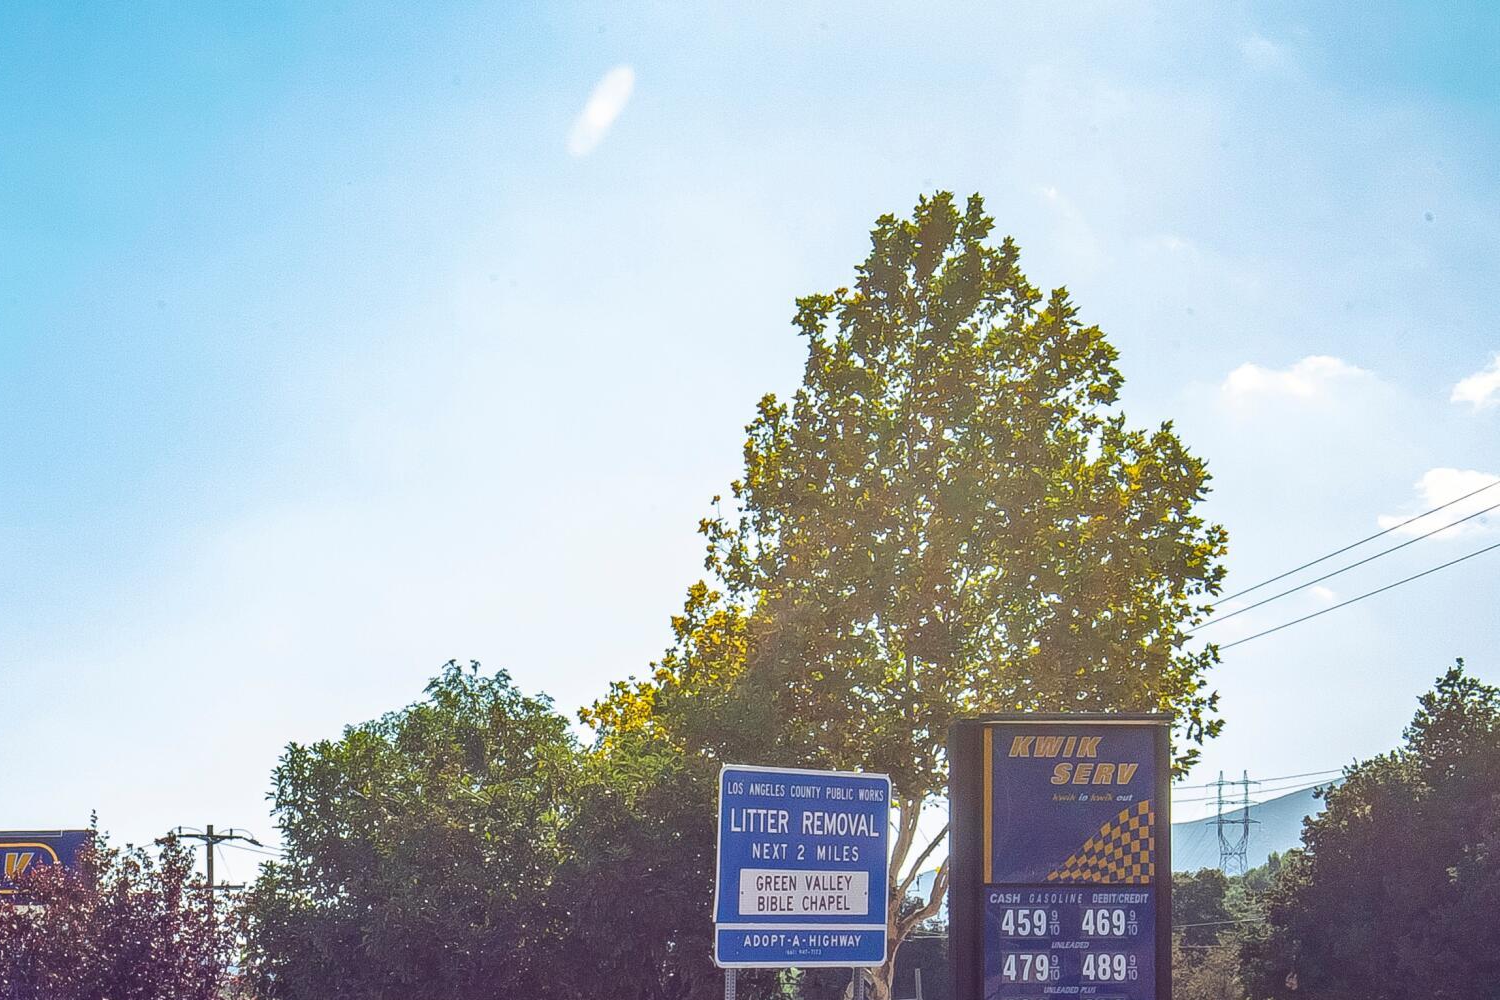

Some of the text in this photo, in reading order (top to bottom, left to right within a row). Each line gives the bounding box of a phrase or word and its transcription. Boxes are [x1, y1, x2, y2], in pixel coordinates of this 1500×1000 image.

[1008, 736, 1102, 757] KWIK
[1051, 763, 1139, 784] SERV
[727, 782, 884, 801] LOS ANGELES COUNTY PUBLIC WORKS
[731, 808, 880, 837] LITTER REMOVAL
[752, 843, 859, 861] NEXT 2 MILES
[756, 876, 852, 892] GREEN VALLEY
[757, 896, 851, 912] BIBLE CHAPEL
[990, 894, 1021, 904] CASH
[1029, 894, 1083, 904] GASOLINE
[1001, 909, 1047, 936] 459
[1082, 909, 1126, 936] 469
[744, 935, 862, 947] ADOPT-A-HIGHWAY
[1003, 954, 1049, 981] 479
[1083, 954, 1127, 981] 489
